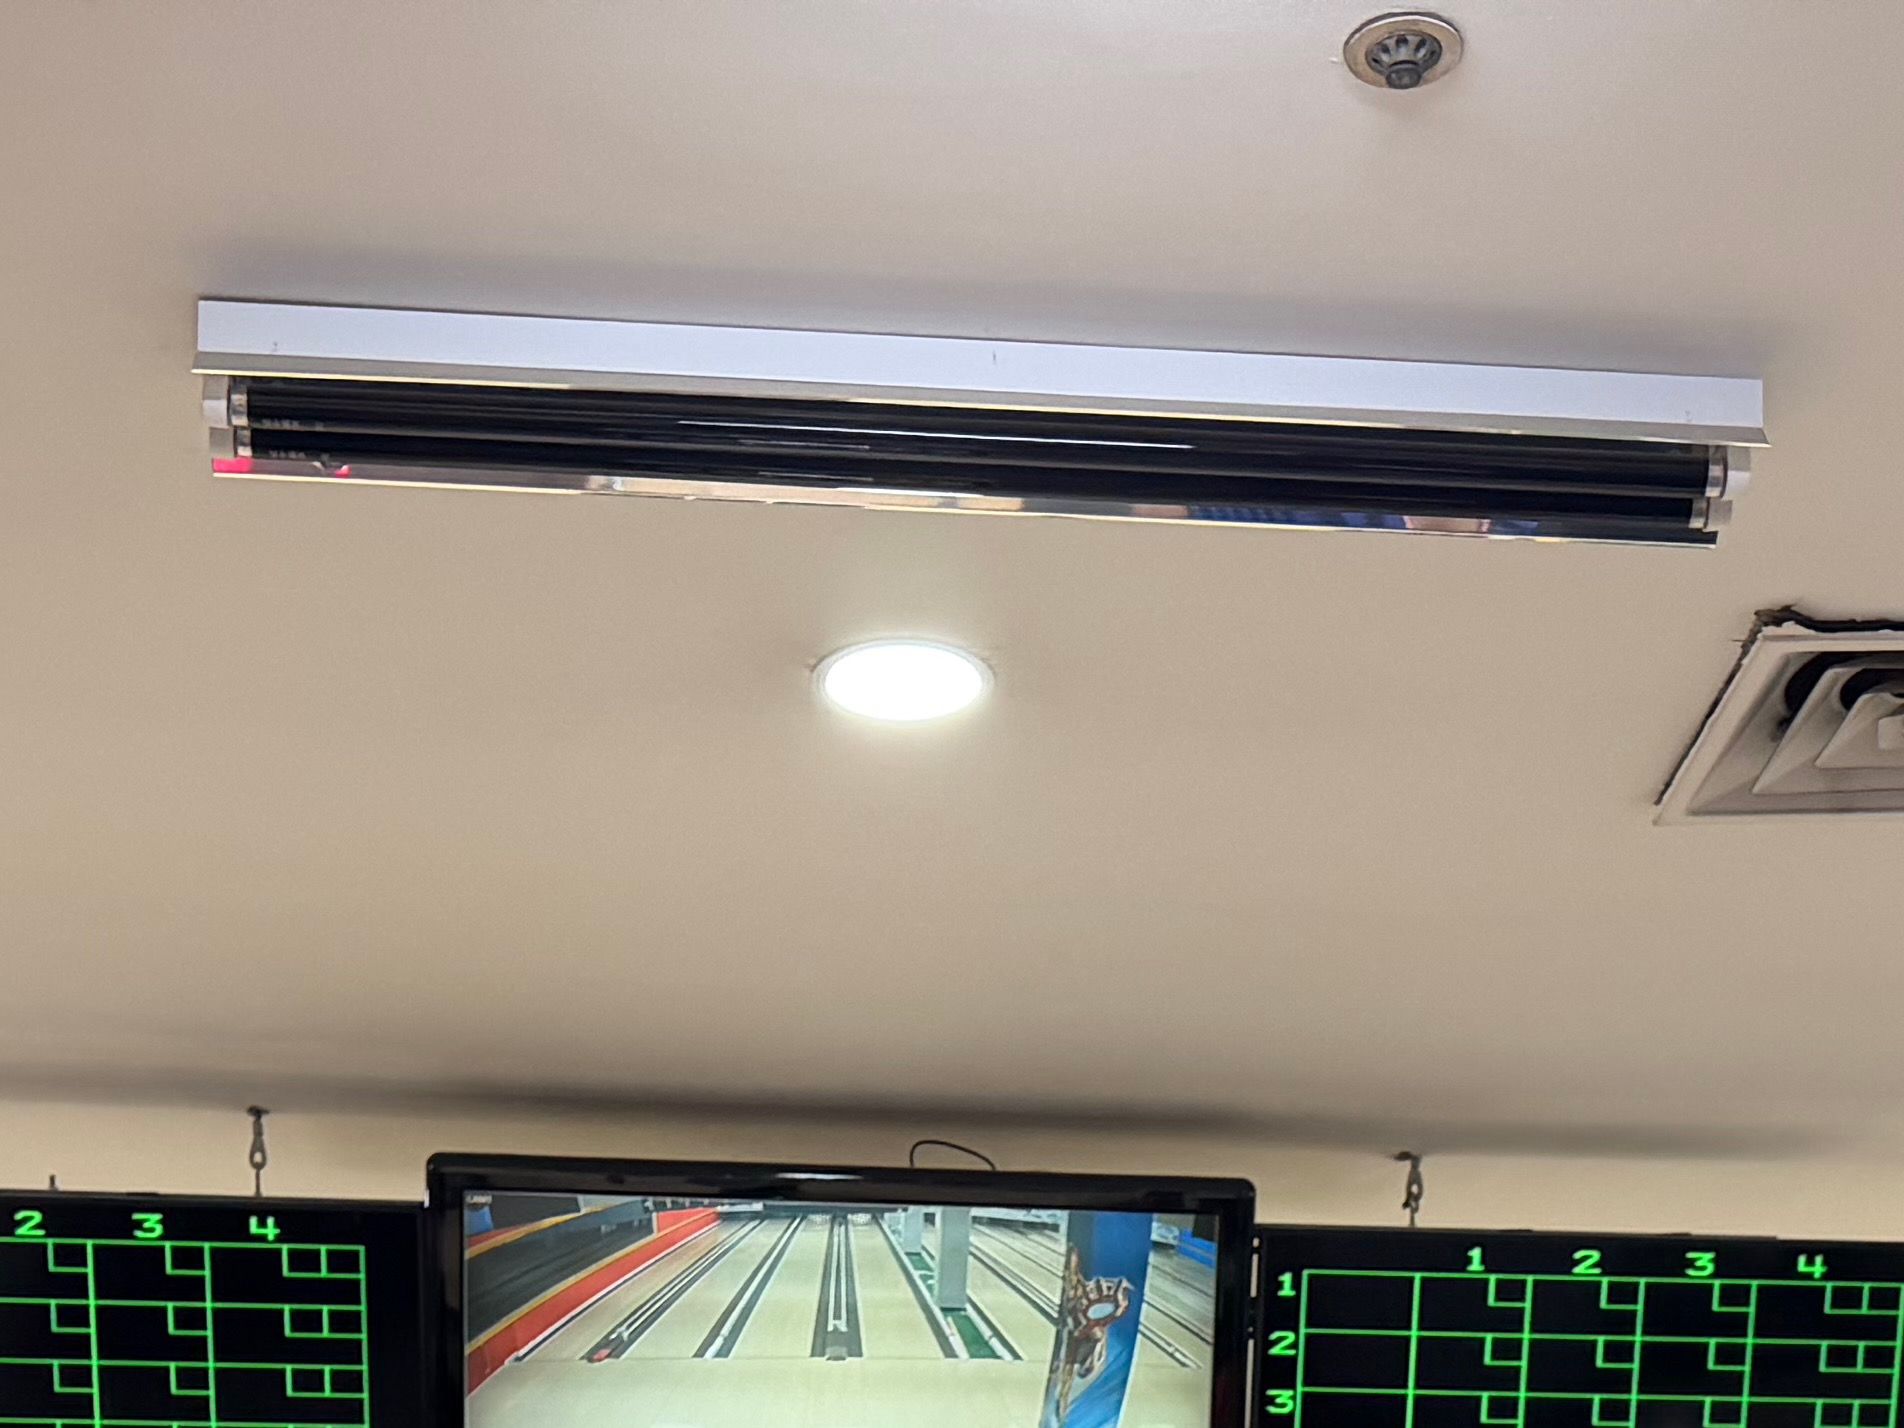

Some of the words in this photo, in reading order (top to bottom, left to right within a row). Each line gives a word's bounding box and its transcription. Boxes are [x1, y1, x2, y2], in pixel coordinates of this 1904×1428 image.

[14, 1210, 46, 1237] 2
[133, 1212, 165, 1239] 3
[249, 1216, 282, 1242] 4
[1466, 1248, 1486, 1272] 1
[1572, 1249, 1601, 1275] 2
[1685, 1251, 1716, 1277] 3
[1797, 1255, 1827, 1280] 4
[1277, 1272, 1296, 1298] 1
[1268, 1330, 1297, 1356] 2
[1265, 1389, 1295, 1415] 3
